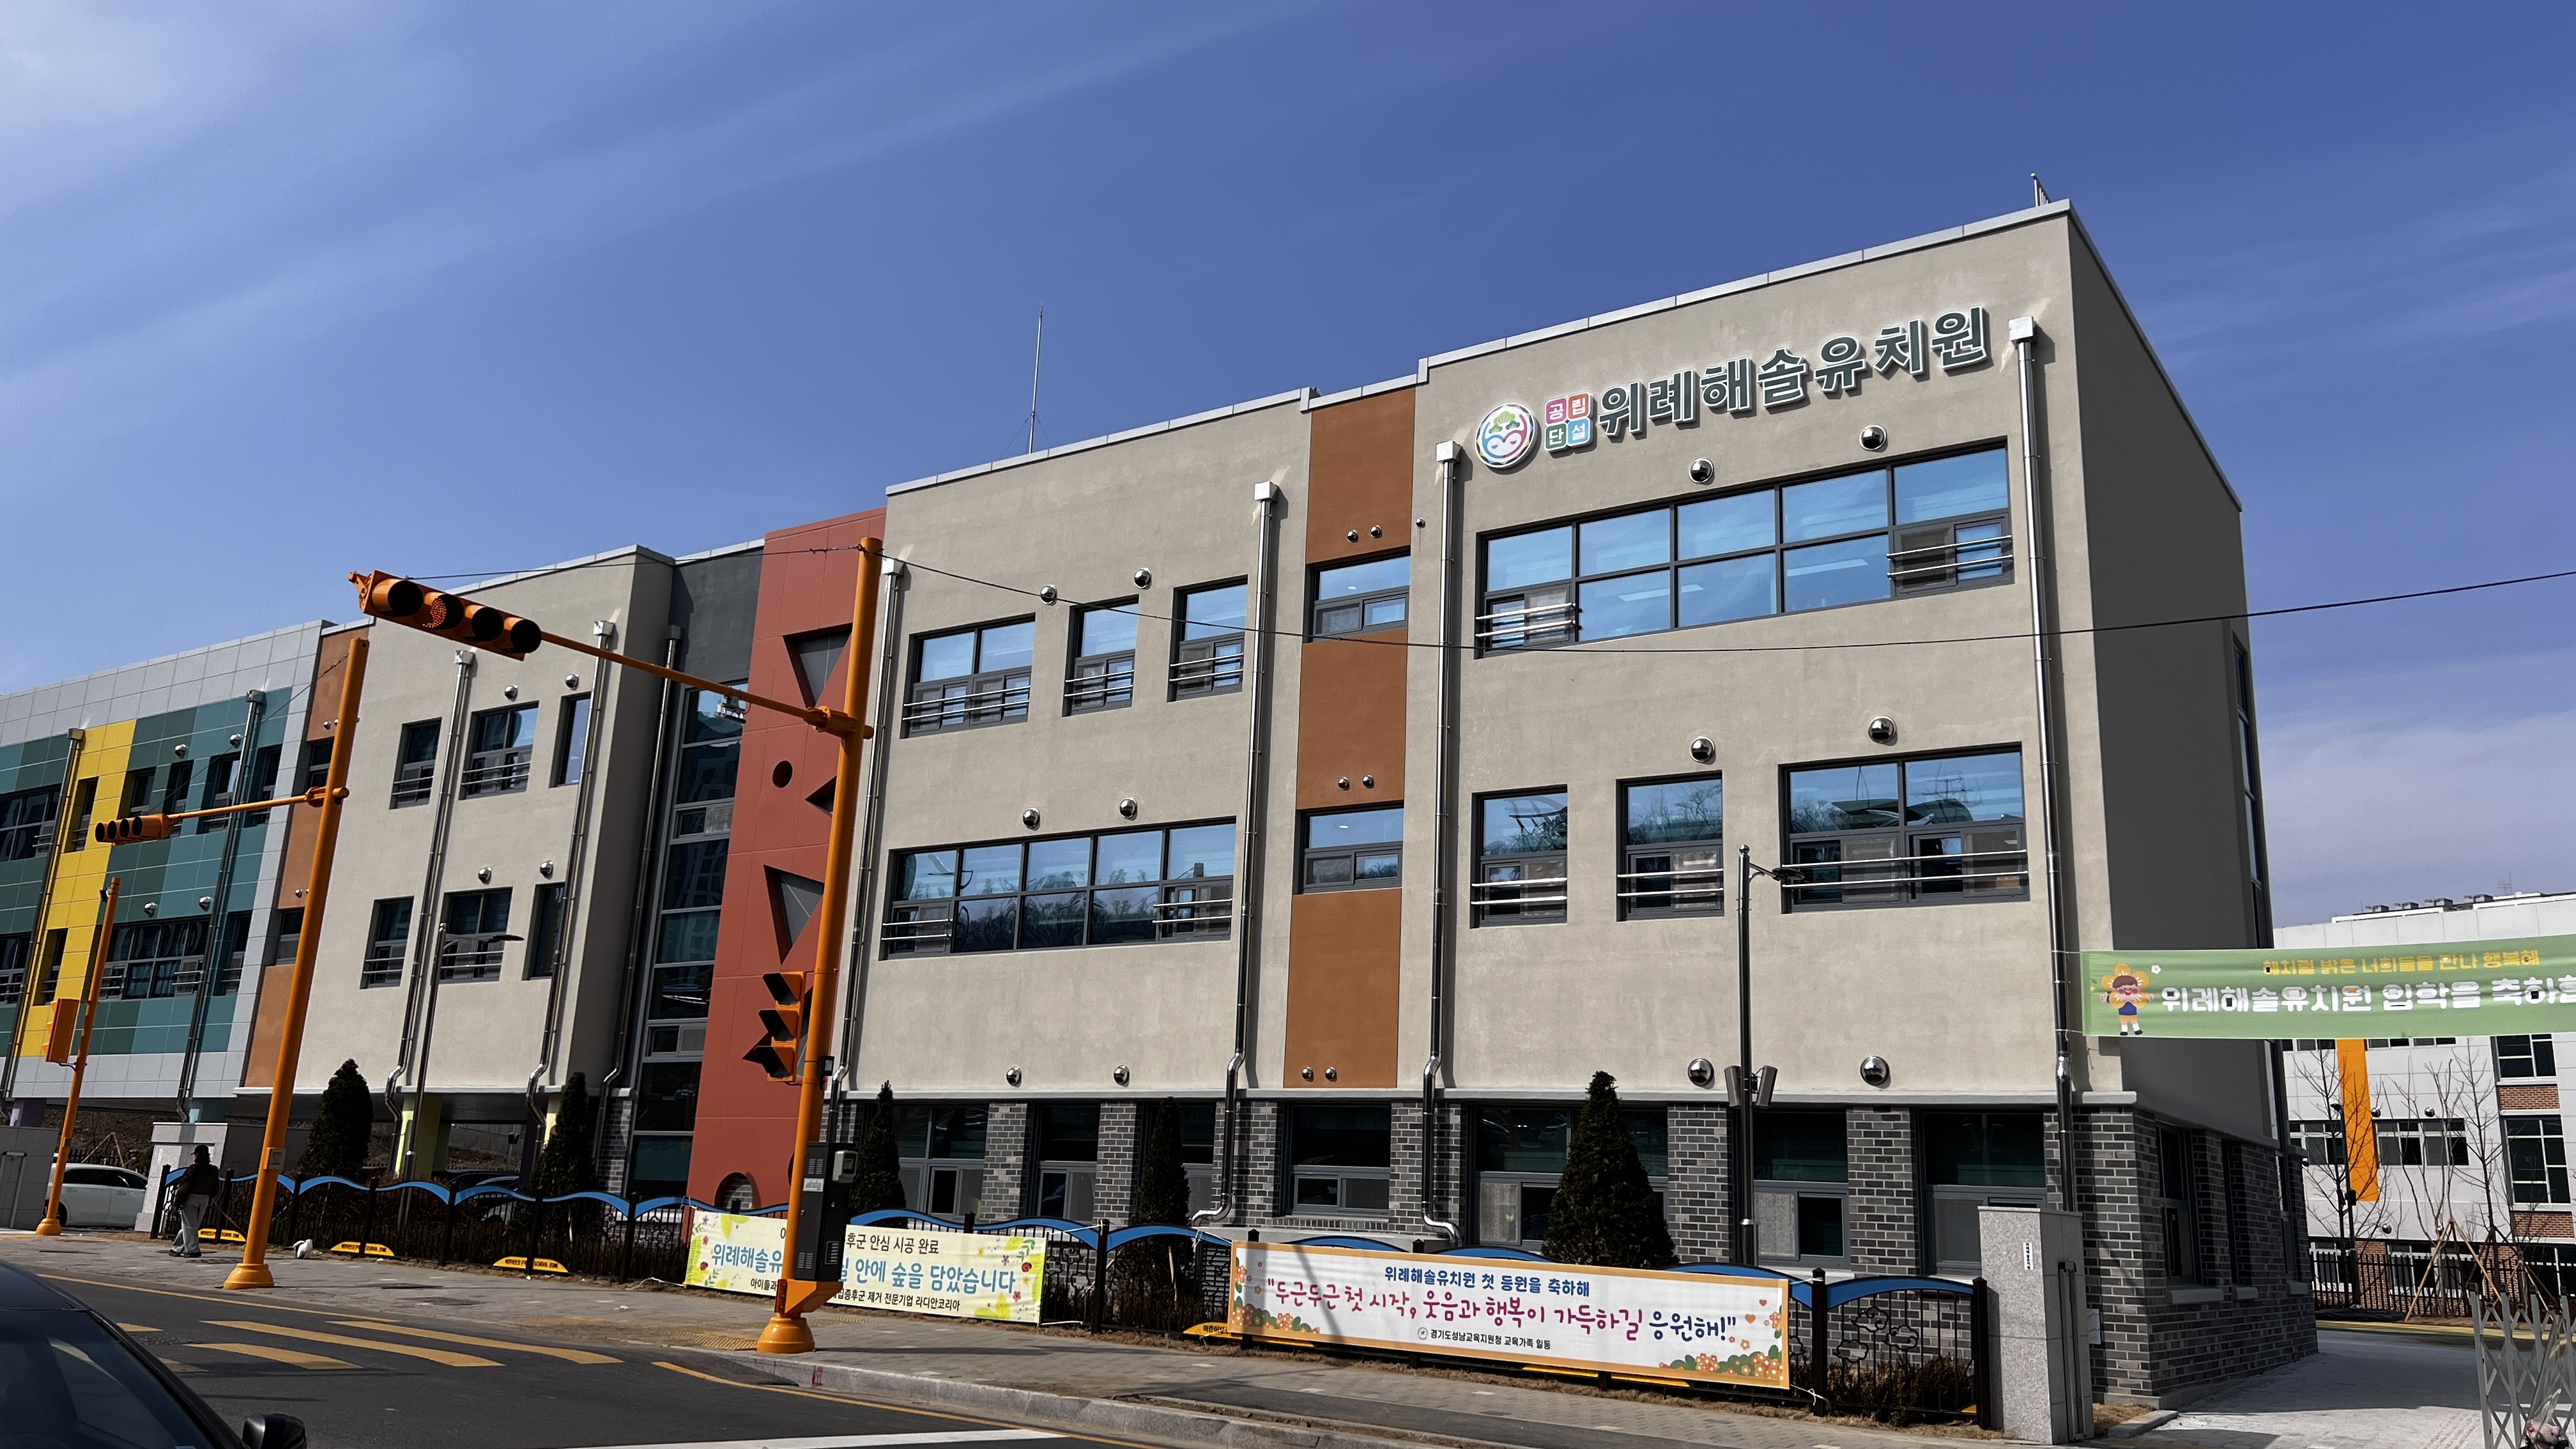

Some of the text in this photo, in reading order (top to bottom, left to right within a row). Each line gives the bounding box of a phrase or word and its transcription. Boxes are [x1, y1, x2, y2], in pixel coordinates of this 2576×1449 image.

[1598, 305, 1987, 437] 위례해솔유치원
[1548, 397, 1586, 420] 공립
[1548, 423, 1586, 445] 단설
[2263, 949, 2540, 976] 해처럼 밝은 너희들을 만나 행복해
[2161, 984, 2372, 1013] 위례해솔유치원
[2382, 981, 2481, 1011] 입학을
[870, 1234, 890, 1252] 안심
[893, 1237, 915, 1254] 시공
[918, 1238, 939, 1255] 완료
[712, 1244, 783, 1273] 위례해솔유
[855, 1259, 887, 1284] 안에
[891, 1262, 924, 1289] 숲을
[930, 1265, 1016, 1294] 담았습니다
[1384, 1266, 1590, 1297] 위례해솔유치원 첫 등원을 축하해
[751, 1278, 960, 1312] 아이들과 집증후군 제거 전문기업 라디안코리아
[1267, 1278, 1736, 1342] "두근두근 첫 시작, 웃음과 행복이 가득하길 응원해!"
[1430, 1329, 1551, 1350] 경기도성남교육지원청 교육가족 일동
